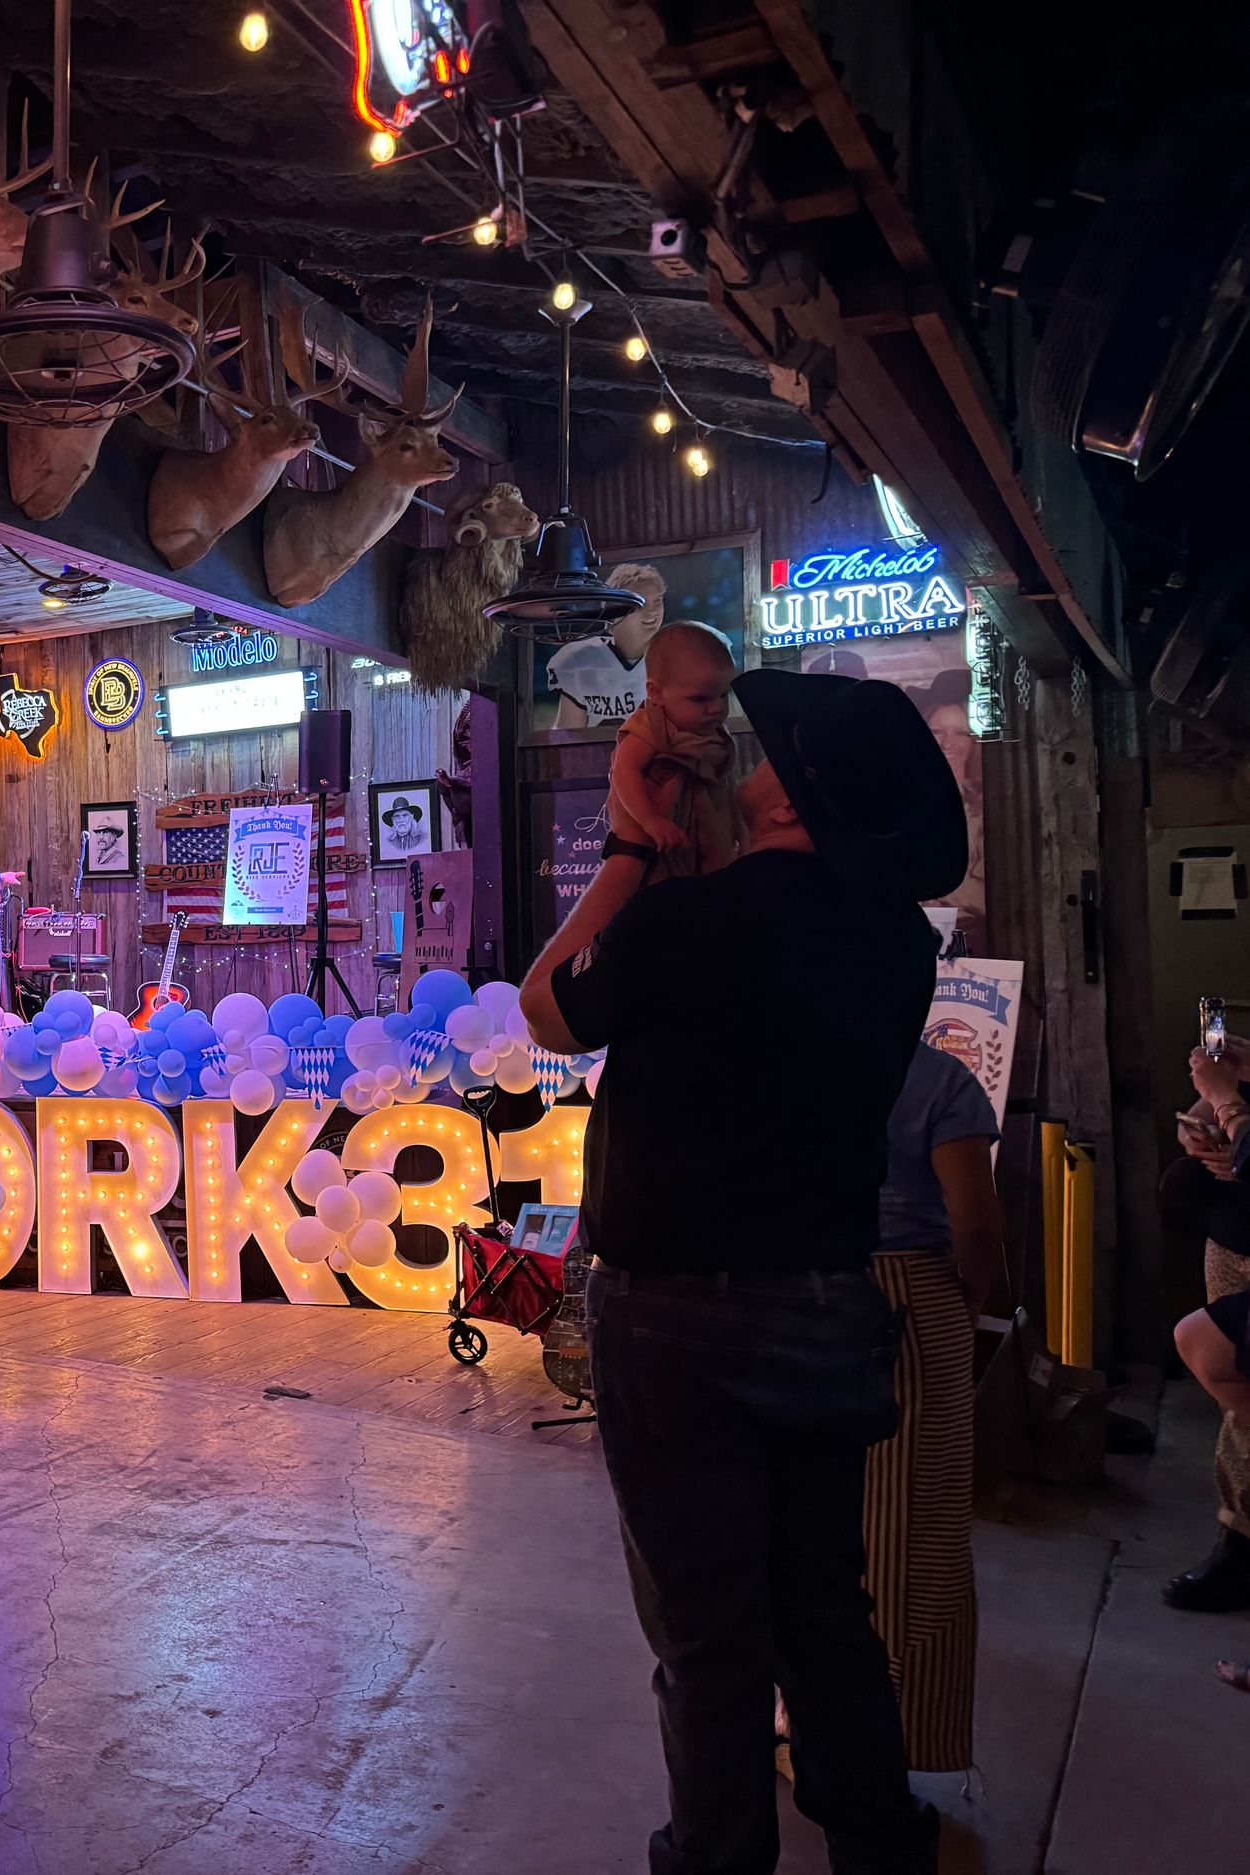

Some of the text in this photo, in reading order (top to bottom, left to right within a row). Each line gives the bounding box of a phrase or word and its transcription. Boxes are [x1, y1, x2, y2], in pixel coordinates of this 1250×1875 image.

[793, 548, 938, 587] Michelob
[759, 576, 965, 634] ULTRA
[761, 616, 959, 646] SUPERIOR LIGHT BEER
[192, 630, 278, 672] Modelo
[2, 695, 48, 714] REBECCA
[9, 706, 46, 722] CREEK
[583, 691, 636, 717] TEXAS
[246, 819, 292, 832] Thank You!
[935, 983, 990, 1003] ank You!
